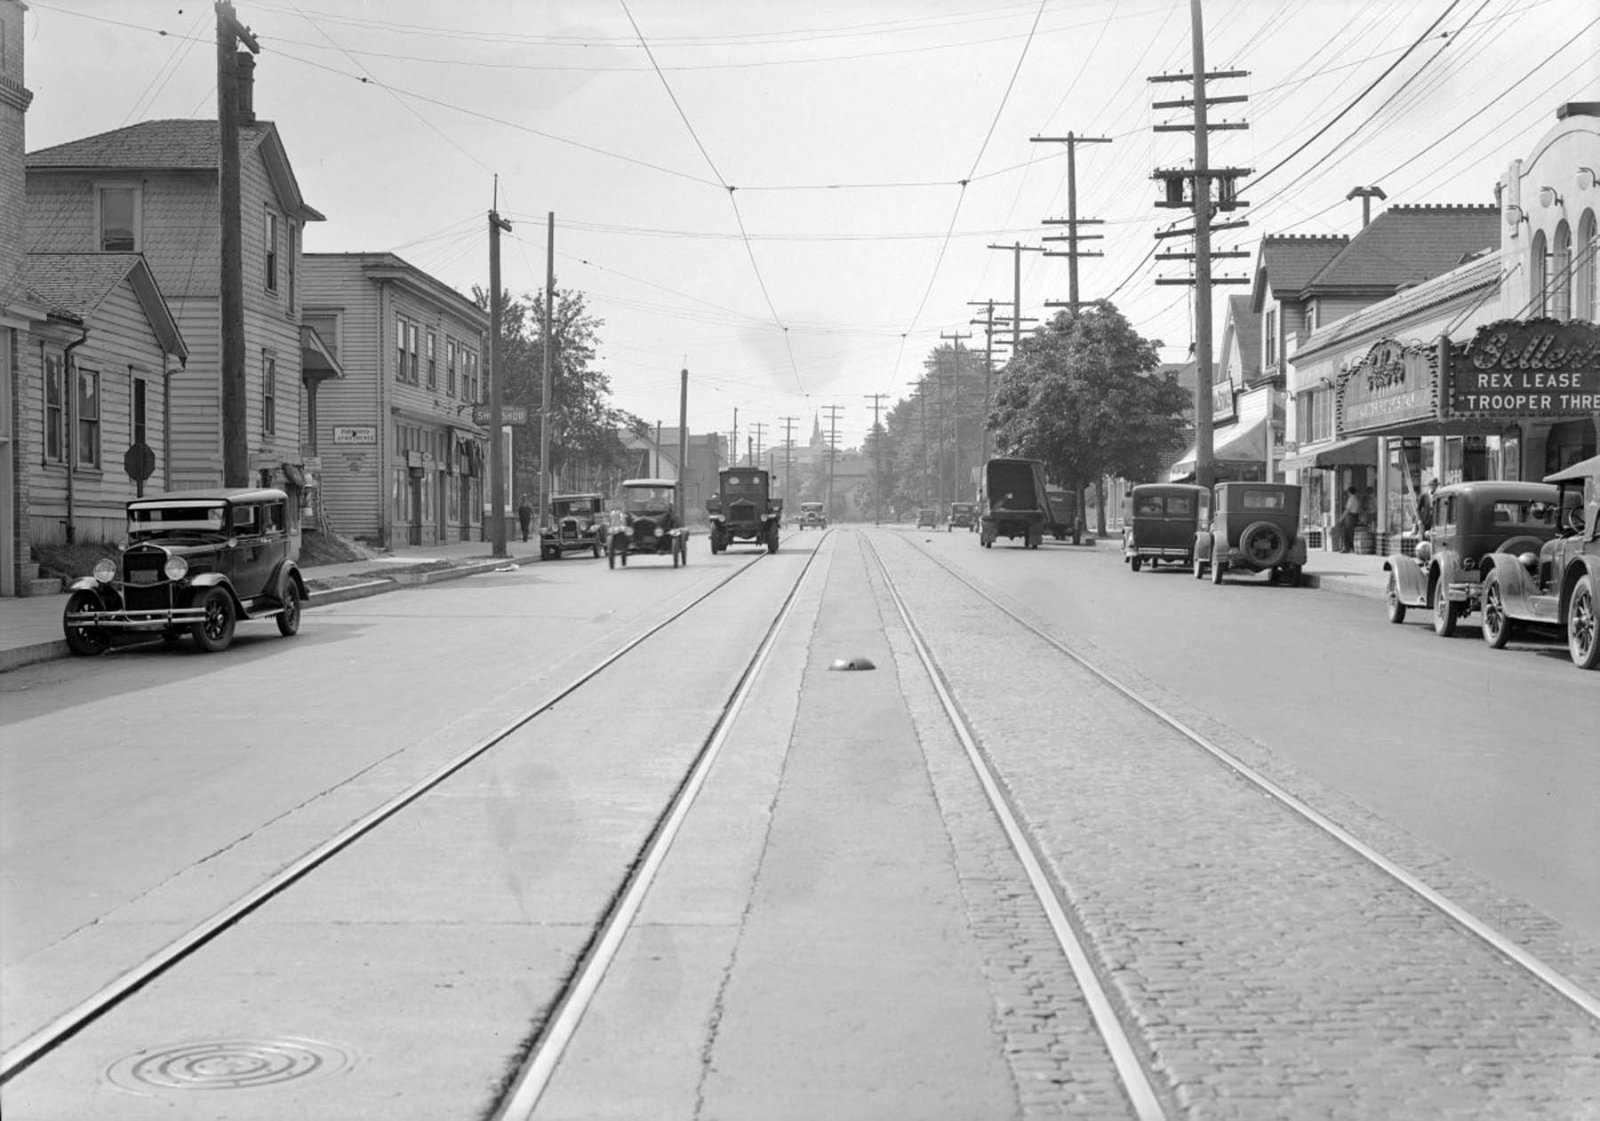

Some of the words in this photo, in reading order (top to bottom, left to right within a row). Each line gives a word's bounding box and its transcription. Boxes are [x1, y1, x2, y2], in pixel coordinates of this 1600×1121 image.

[1478, 373, 1513, 388] REX
[1523, 373, 1581, 388] LEASE
[1459, 395, 1552, 410] "TROOPER
